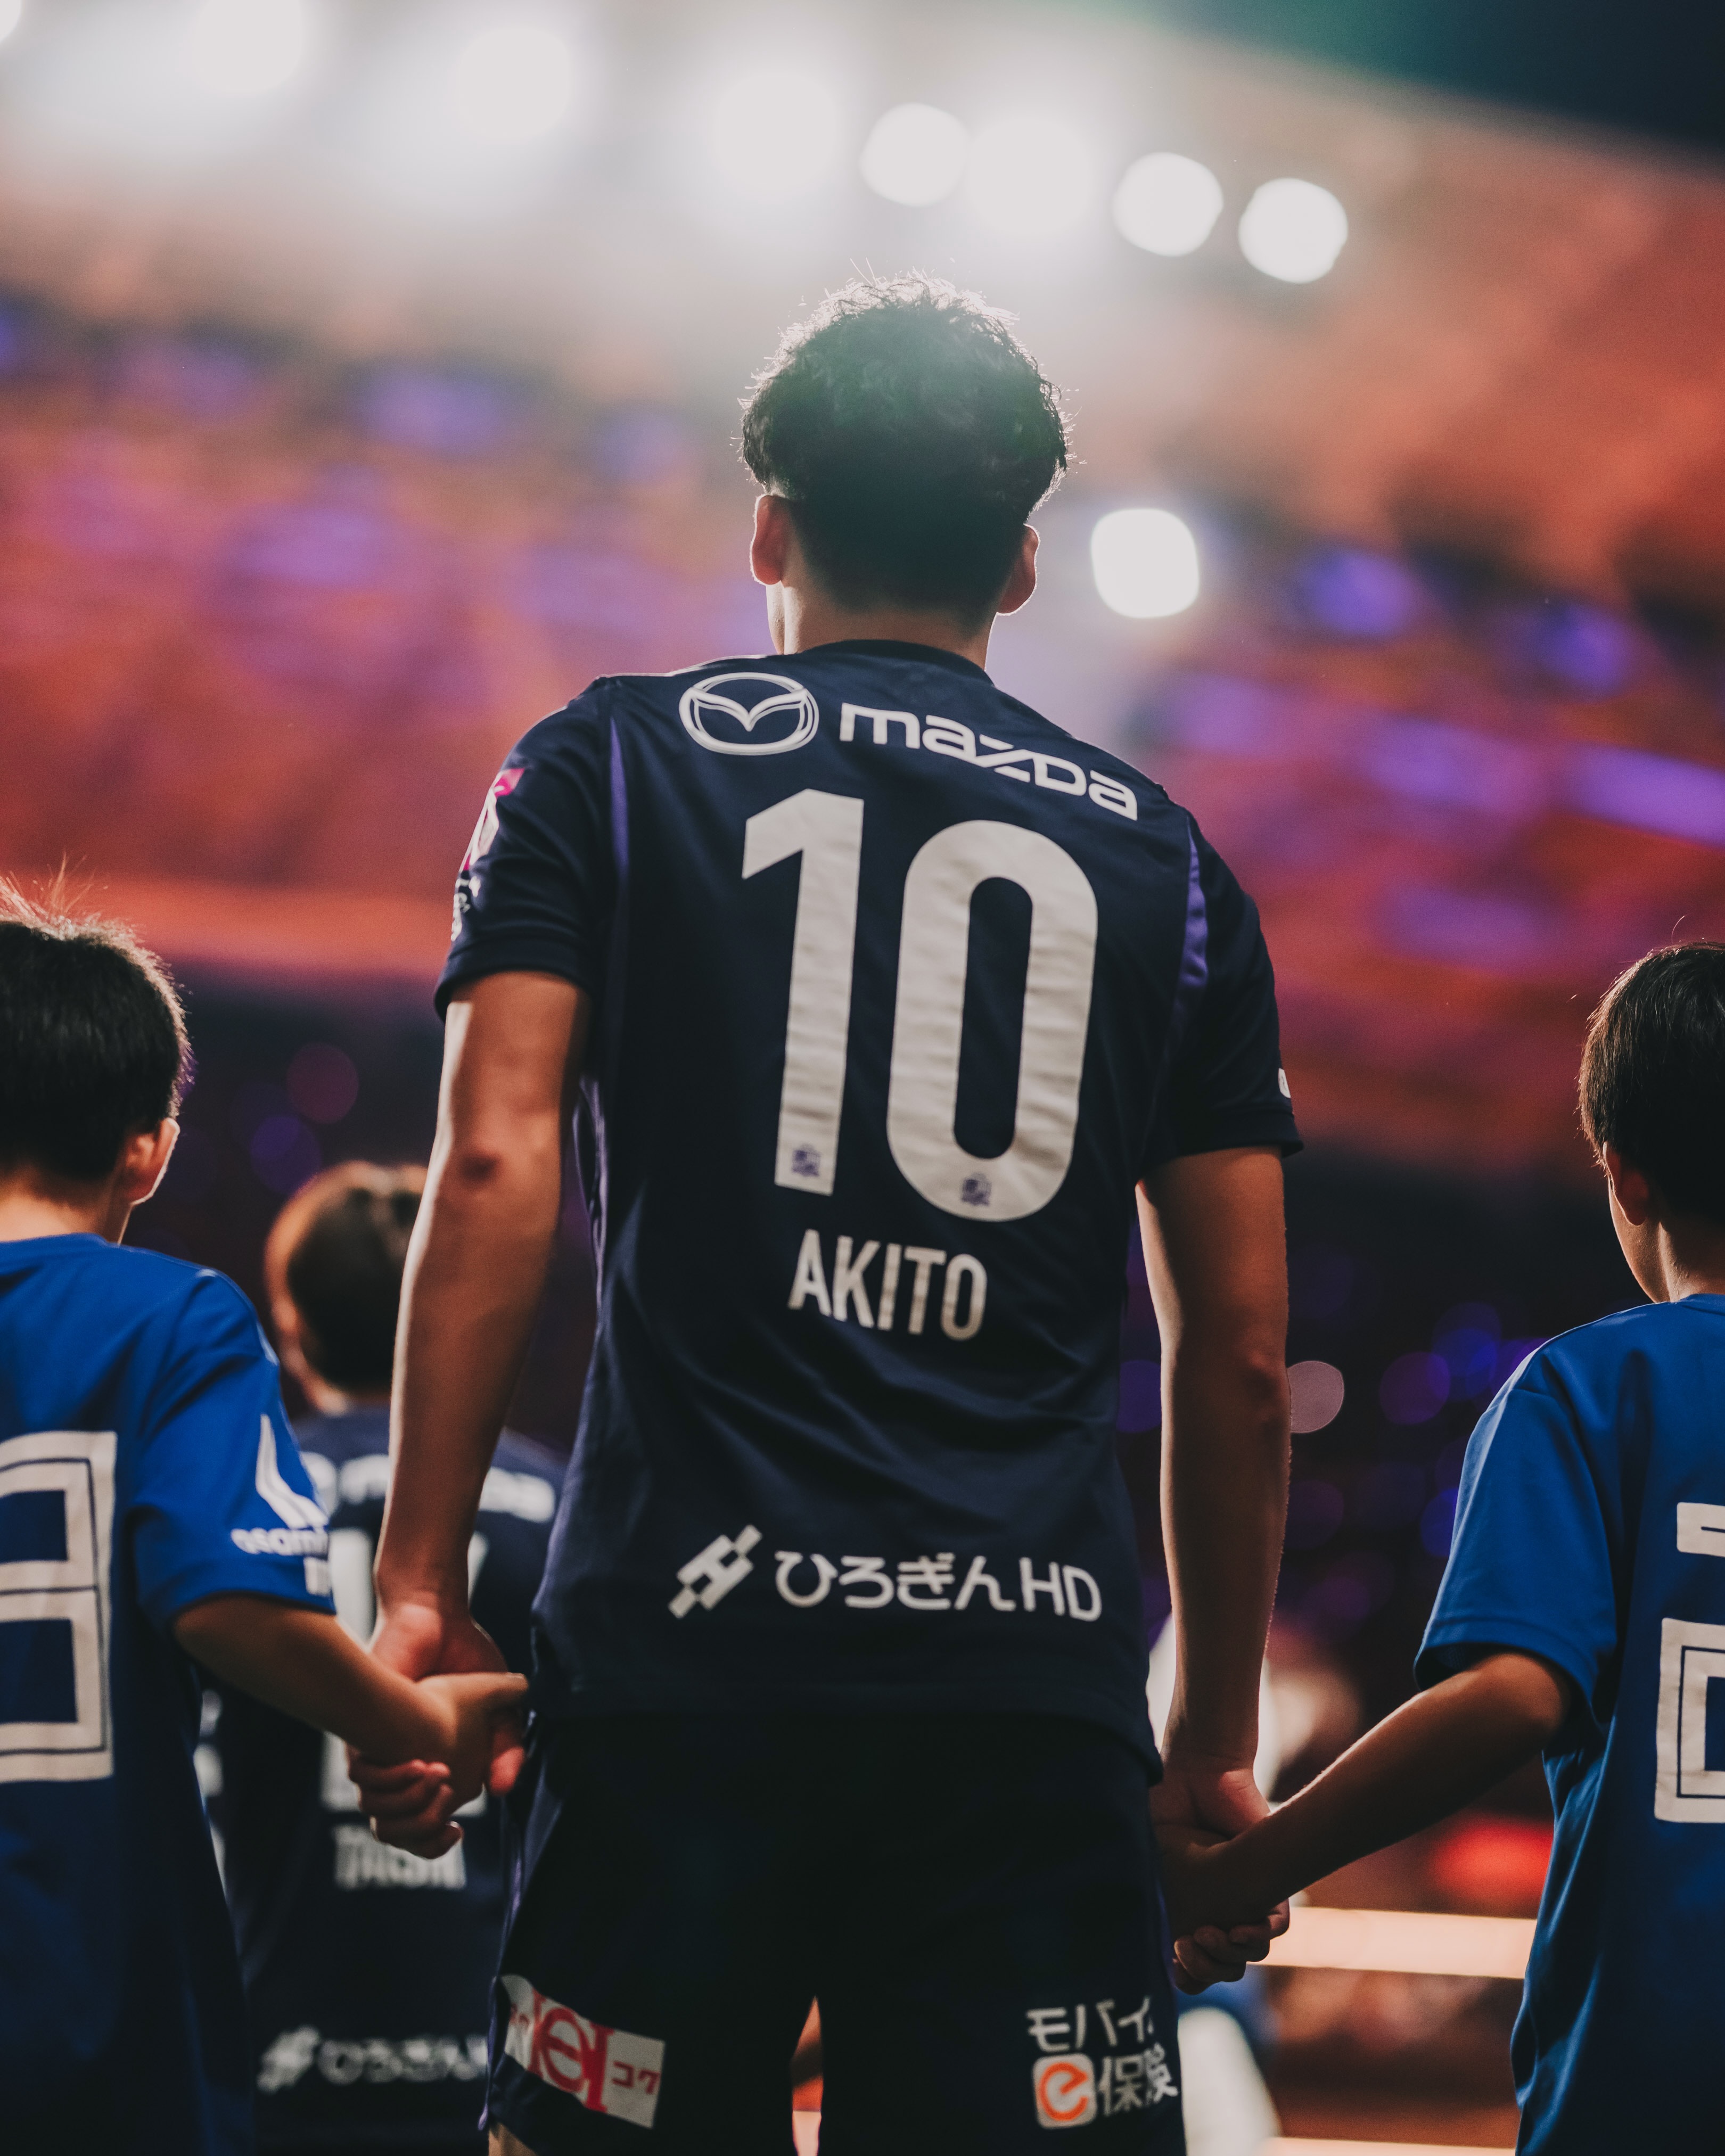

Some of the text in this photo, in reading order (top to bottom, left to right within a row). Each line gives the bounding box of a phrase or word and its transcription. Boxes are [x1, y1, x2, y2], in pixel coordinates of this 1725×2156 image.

[742, 788, 1098, 1222] 10
[787, 1228, 988, 1342] AKITO
[775, 1550, 1102, 1622] ひろぎんHD
[1025, 1995, 1154, 2053] モバイ
